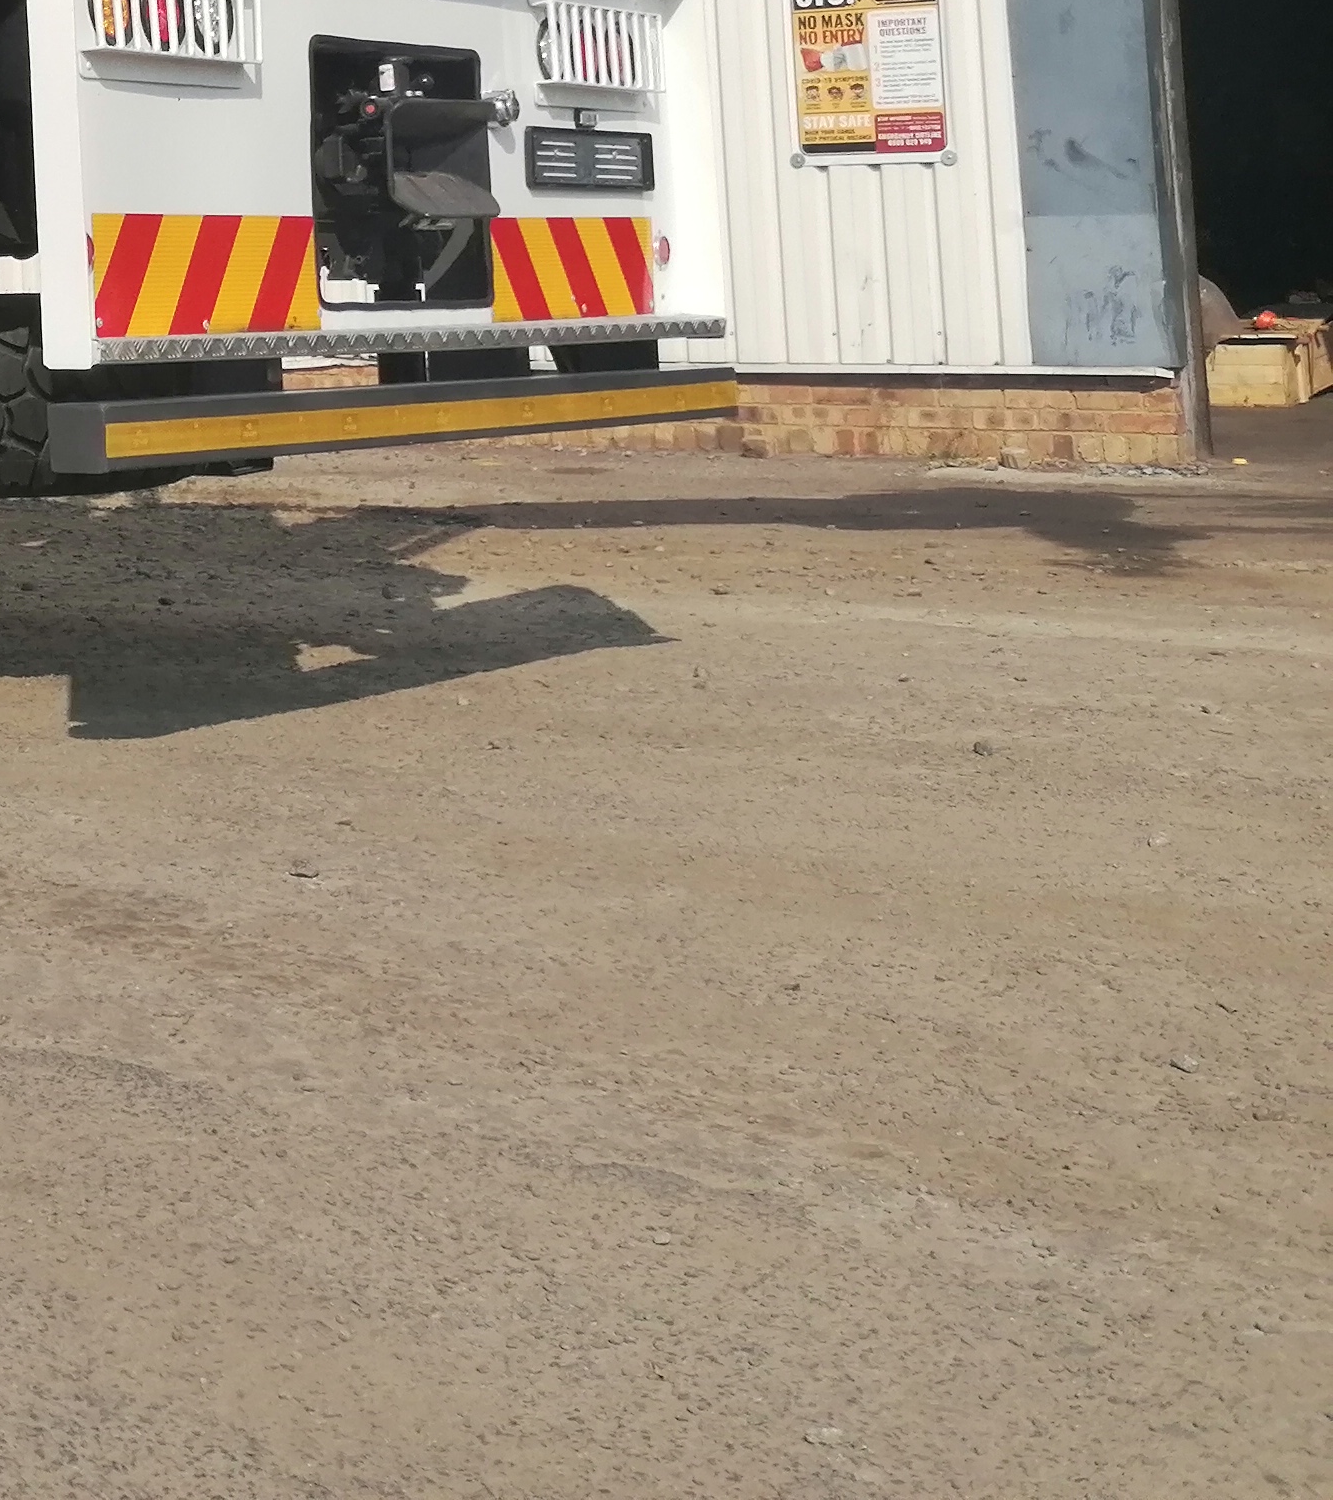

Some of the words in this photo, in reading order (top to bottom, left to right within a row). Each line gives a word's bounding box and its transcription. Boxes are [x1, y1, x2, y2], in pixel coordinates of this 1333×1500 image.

[798, 15, 817, 30] NO
[821, 12, 865, 28] MASK
[877, 17, 927, 28] IMPORTANT
[799, 30, 817, 45] NO
[822, 26, 865, 44] ENTRY
[879, 27, 927, 37] QUESTIONS
[803, 115, 834, 130] STAY
[838, 114, 873, 128] SAFE
